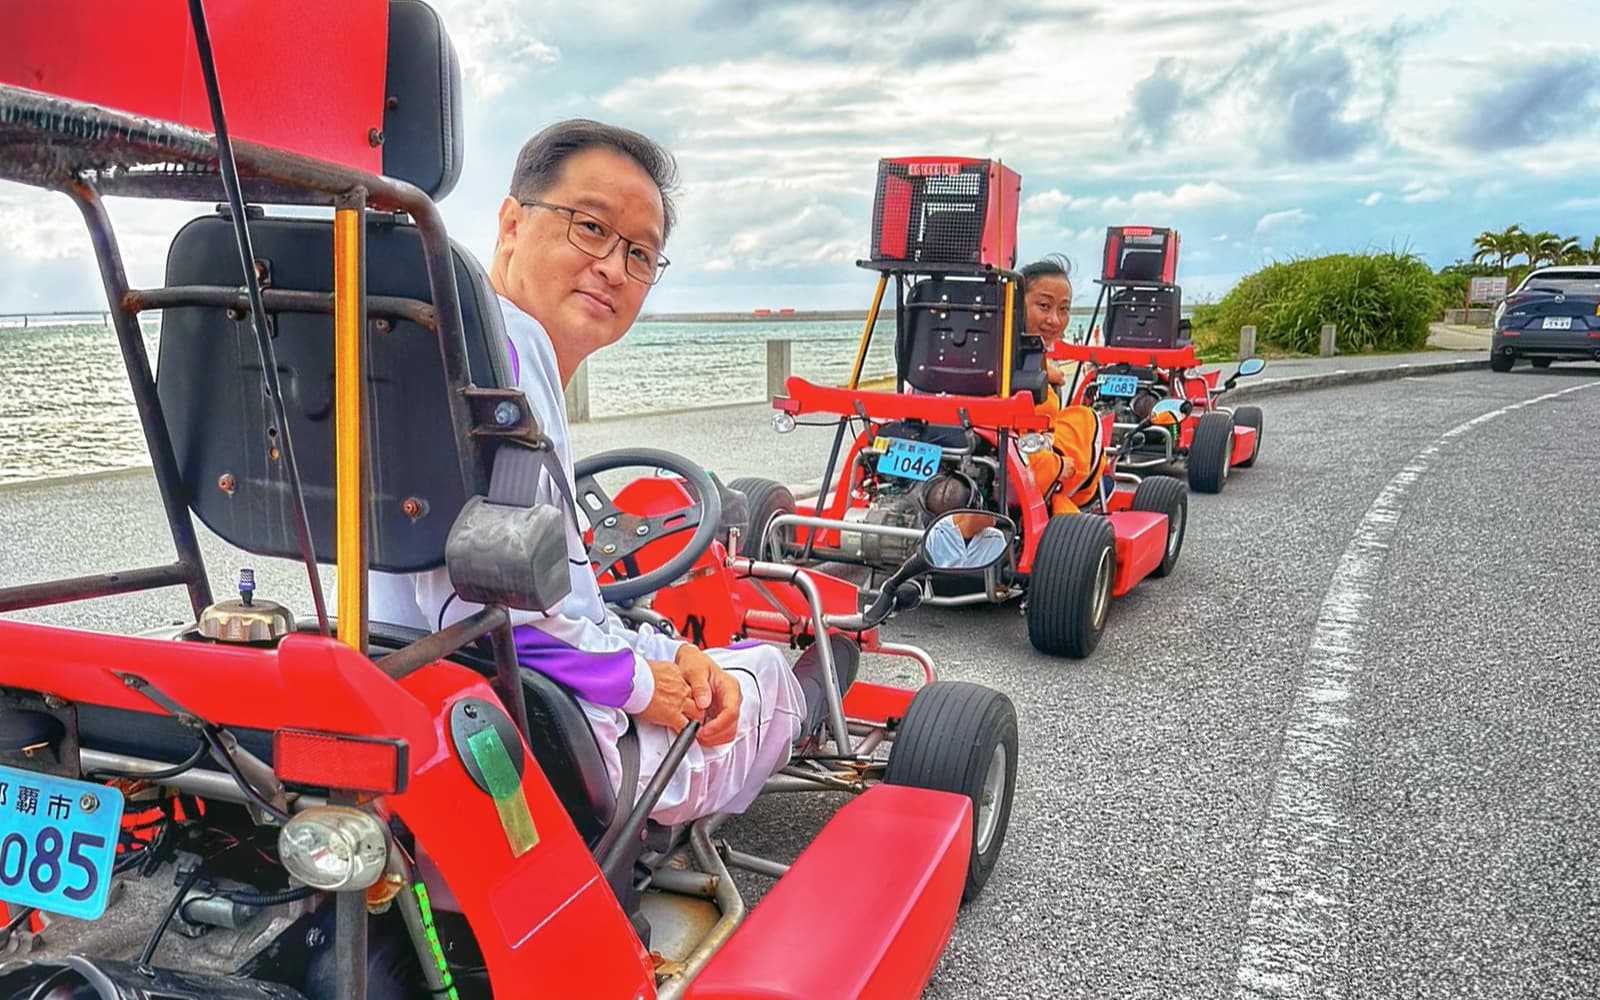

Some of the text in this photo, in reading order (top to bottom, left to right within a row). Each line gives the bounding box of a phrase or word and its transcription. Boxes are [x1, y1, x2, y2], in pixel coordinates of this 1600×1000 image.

[1110, 382, 1135, 395] 1083
[893, 455, 935, 477] 1046
[0, 826, 106, 901] 085
